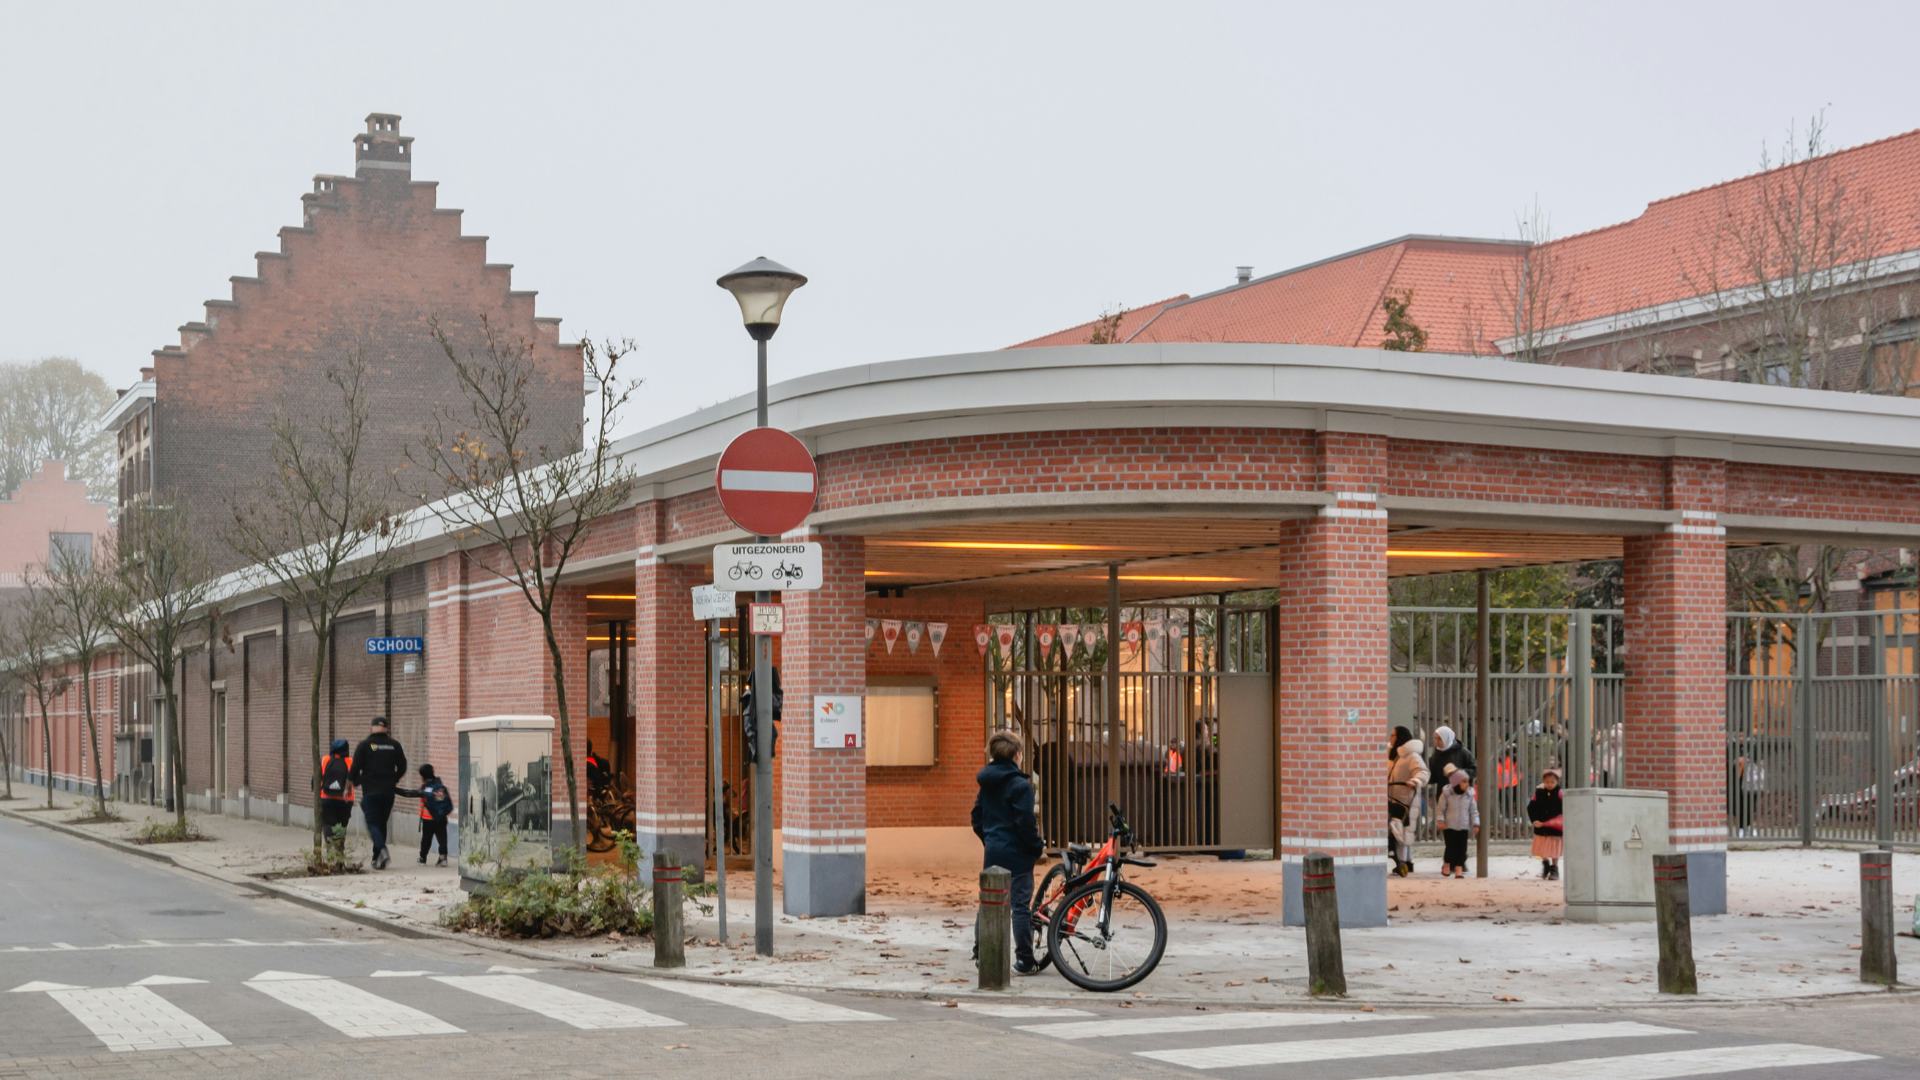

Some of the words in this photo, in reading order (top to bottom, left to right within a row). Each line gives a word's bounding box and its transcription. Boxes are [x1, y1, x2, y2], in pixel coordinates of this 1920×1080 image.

[732, 545, 805, 555] UITGEZONDERD
[368, 639, 422, 651] SCHOOL
[847, 736, 854, 745] A
